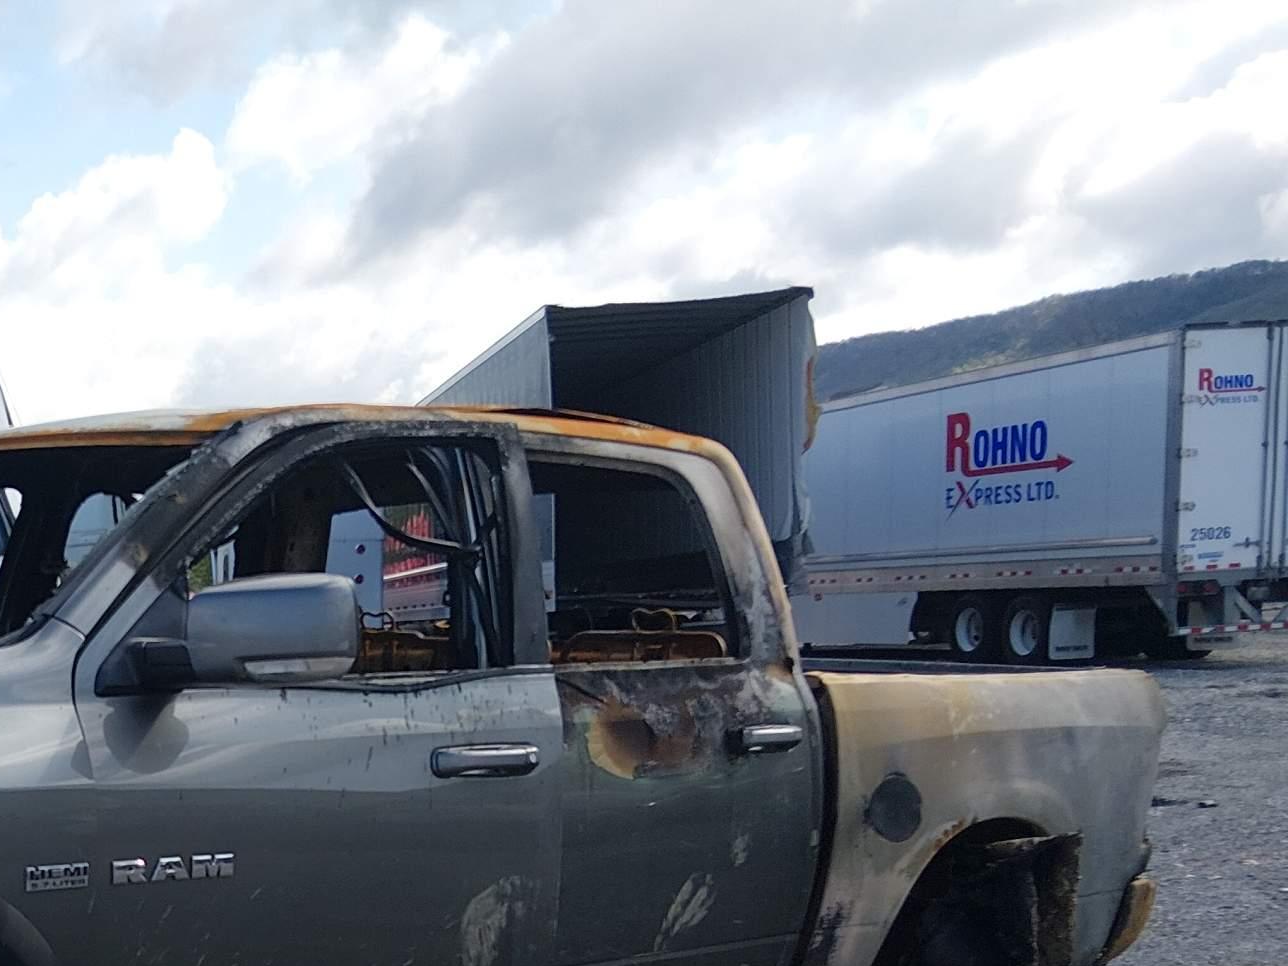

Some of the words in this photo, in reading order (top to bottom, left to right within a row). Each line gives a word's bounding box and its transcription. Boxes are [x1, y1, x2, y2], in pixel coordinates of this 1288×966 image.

[1198, 368, 1254, 392] ROHNO
[946, 412, 1048, 477] ROHNO
[945, 479, 1023, 521] EXPRESS
[1026, 480, 1061, 502] LTD.
[1191, 526, 1232, 541] 25026
[29, 864, 89, 881] HEMI
[111, 852, 236, 886] RAM
